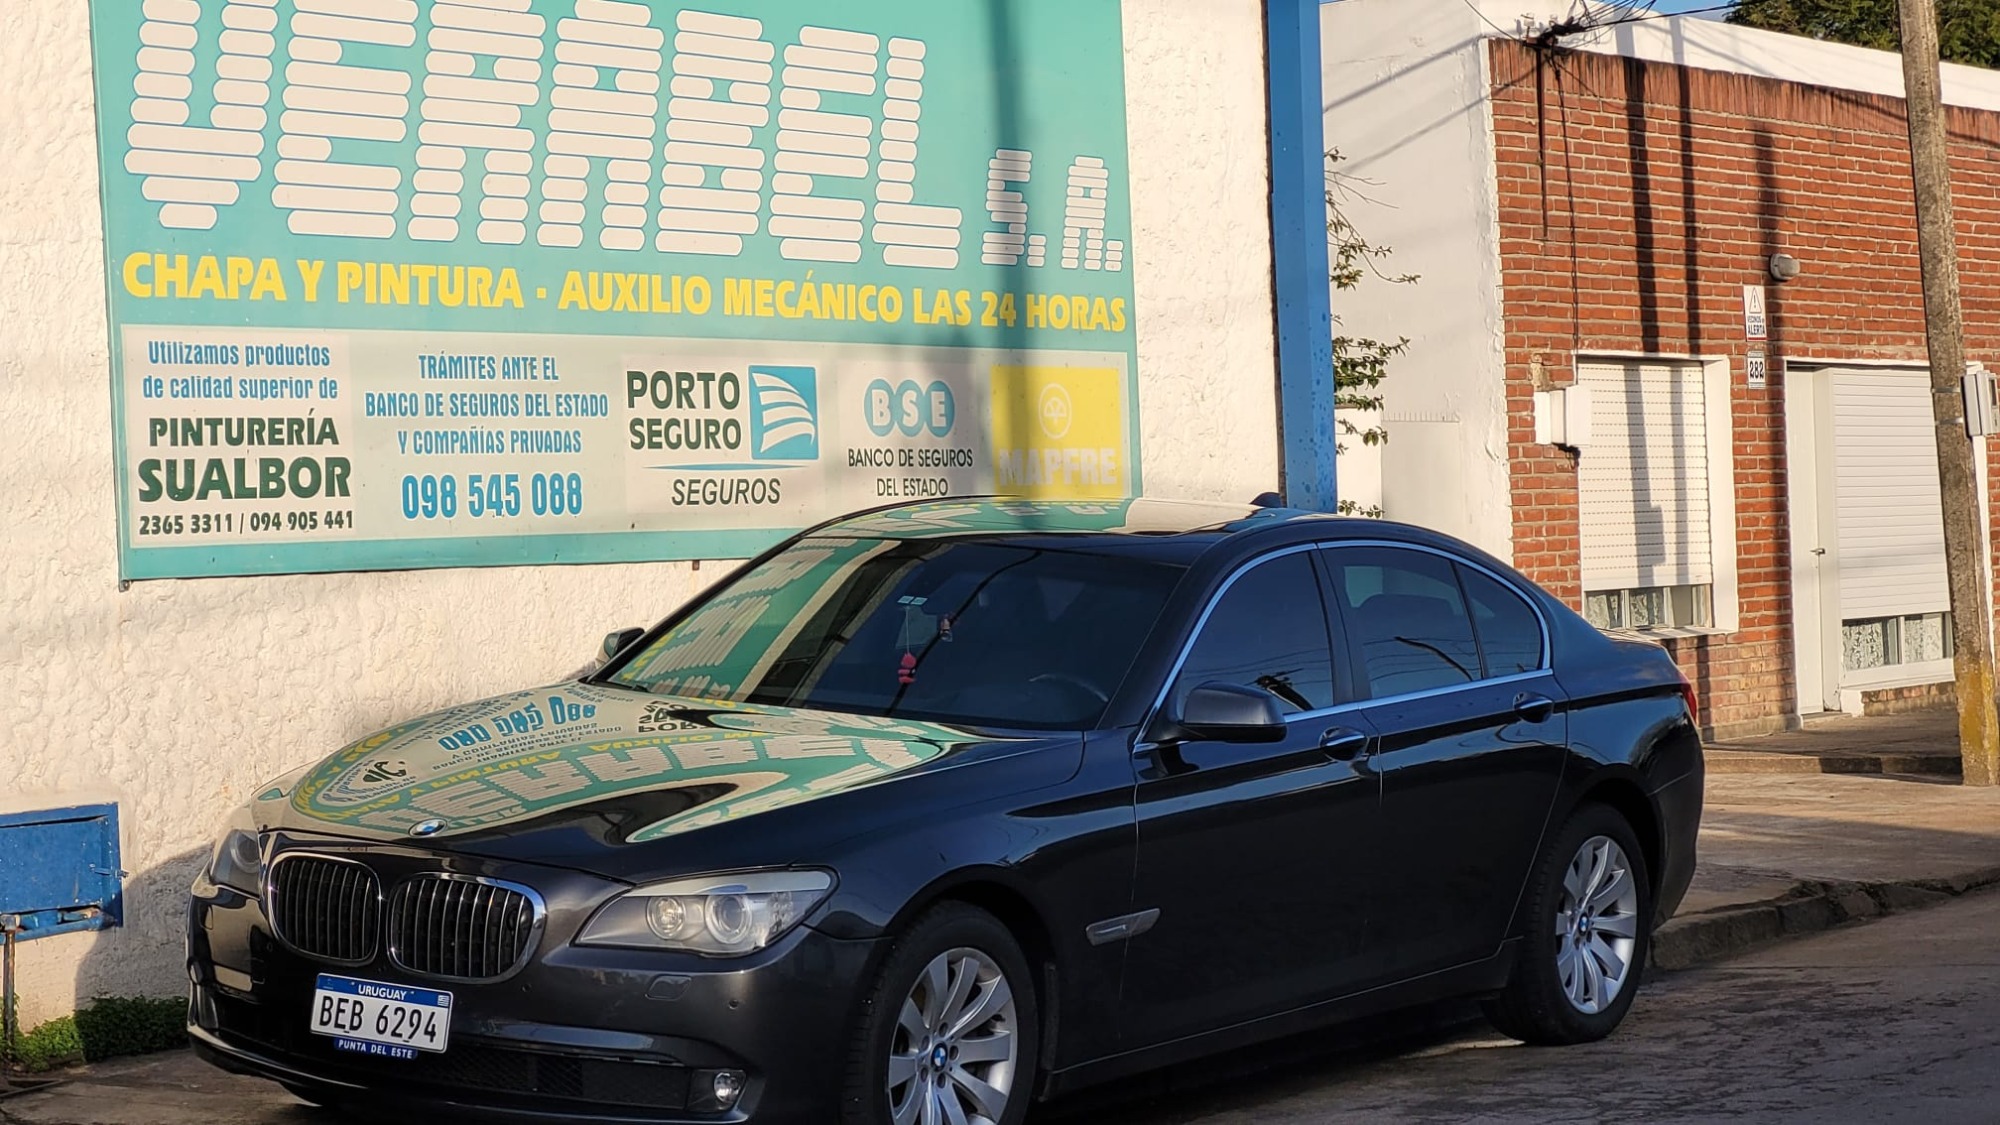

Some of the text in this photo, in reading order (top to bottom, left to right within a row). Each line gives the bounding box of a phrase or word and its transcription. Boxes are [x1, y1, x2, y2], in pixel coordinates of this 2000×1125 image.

[124, 0, 962, 269] VERABEL
[123, 252, 287, 301] CHAPA
[296, 260, 324, 303] Y
[337, 262, 524, 308] PINTURA
[558, 271, 711, 315] AUXILIO
[723, 270, 903, 323] MECÁNICO
[913, 288, 972, 326] LAS
[981, 291, 1017, 328] 24
[1026, 296, 1126, 332] HORAS
[1748, 324, 1765, 335] ALERTA
[148, 341, 330, 367] Utilizamos productos
[418, 350, 559, 380] TRÁMITES ANTE EL
[1750, 360, 1764, 379] 282
[143, 375, 338, 400] de calidad superior de
[627, 370, 740, 410] PORTO
[365, 392, 609, 417] BANCO DE SEGUROS DEL ESTADO
[869, 386, 949, 430] BSE
[149, 408, 340, 446] PINTURERÍA
[398, 425, 582, 454] Y COMPAÑÍAS PRIVADAS
[629, 417, 741, 450] SEGURO
[848, 448, 973, 467] BANCO DE SEGUROS
[1000, 447, 1117, 485] MAPFRE
[138, 456, 351, 502] SUALBOR
[672, 478, 781, 506] SEGUROS
[876, 478, 948, 497] DEL ESTADO
[402, 473, 582, 519] 098 545 088
[139, 515, 183, 535] 2365
[190, 513, 232, 534] 3311
[250, 512, 282, 531] 094
[287, 511, 318, 530] 905
[324, 510, 353, 529] 441
[358, 985, 407, 1001] URUGUAY
[319, 996, 437, 1043] BEB 6294
[338, 1039, 413, 1059] PUNTA DEL ESTE
